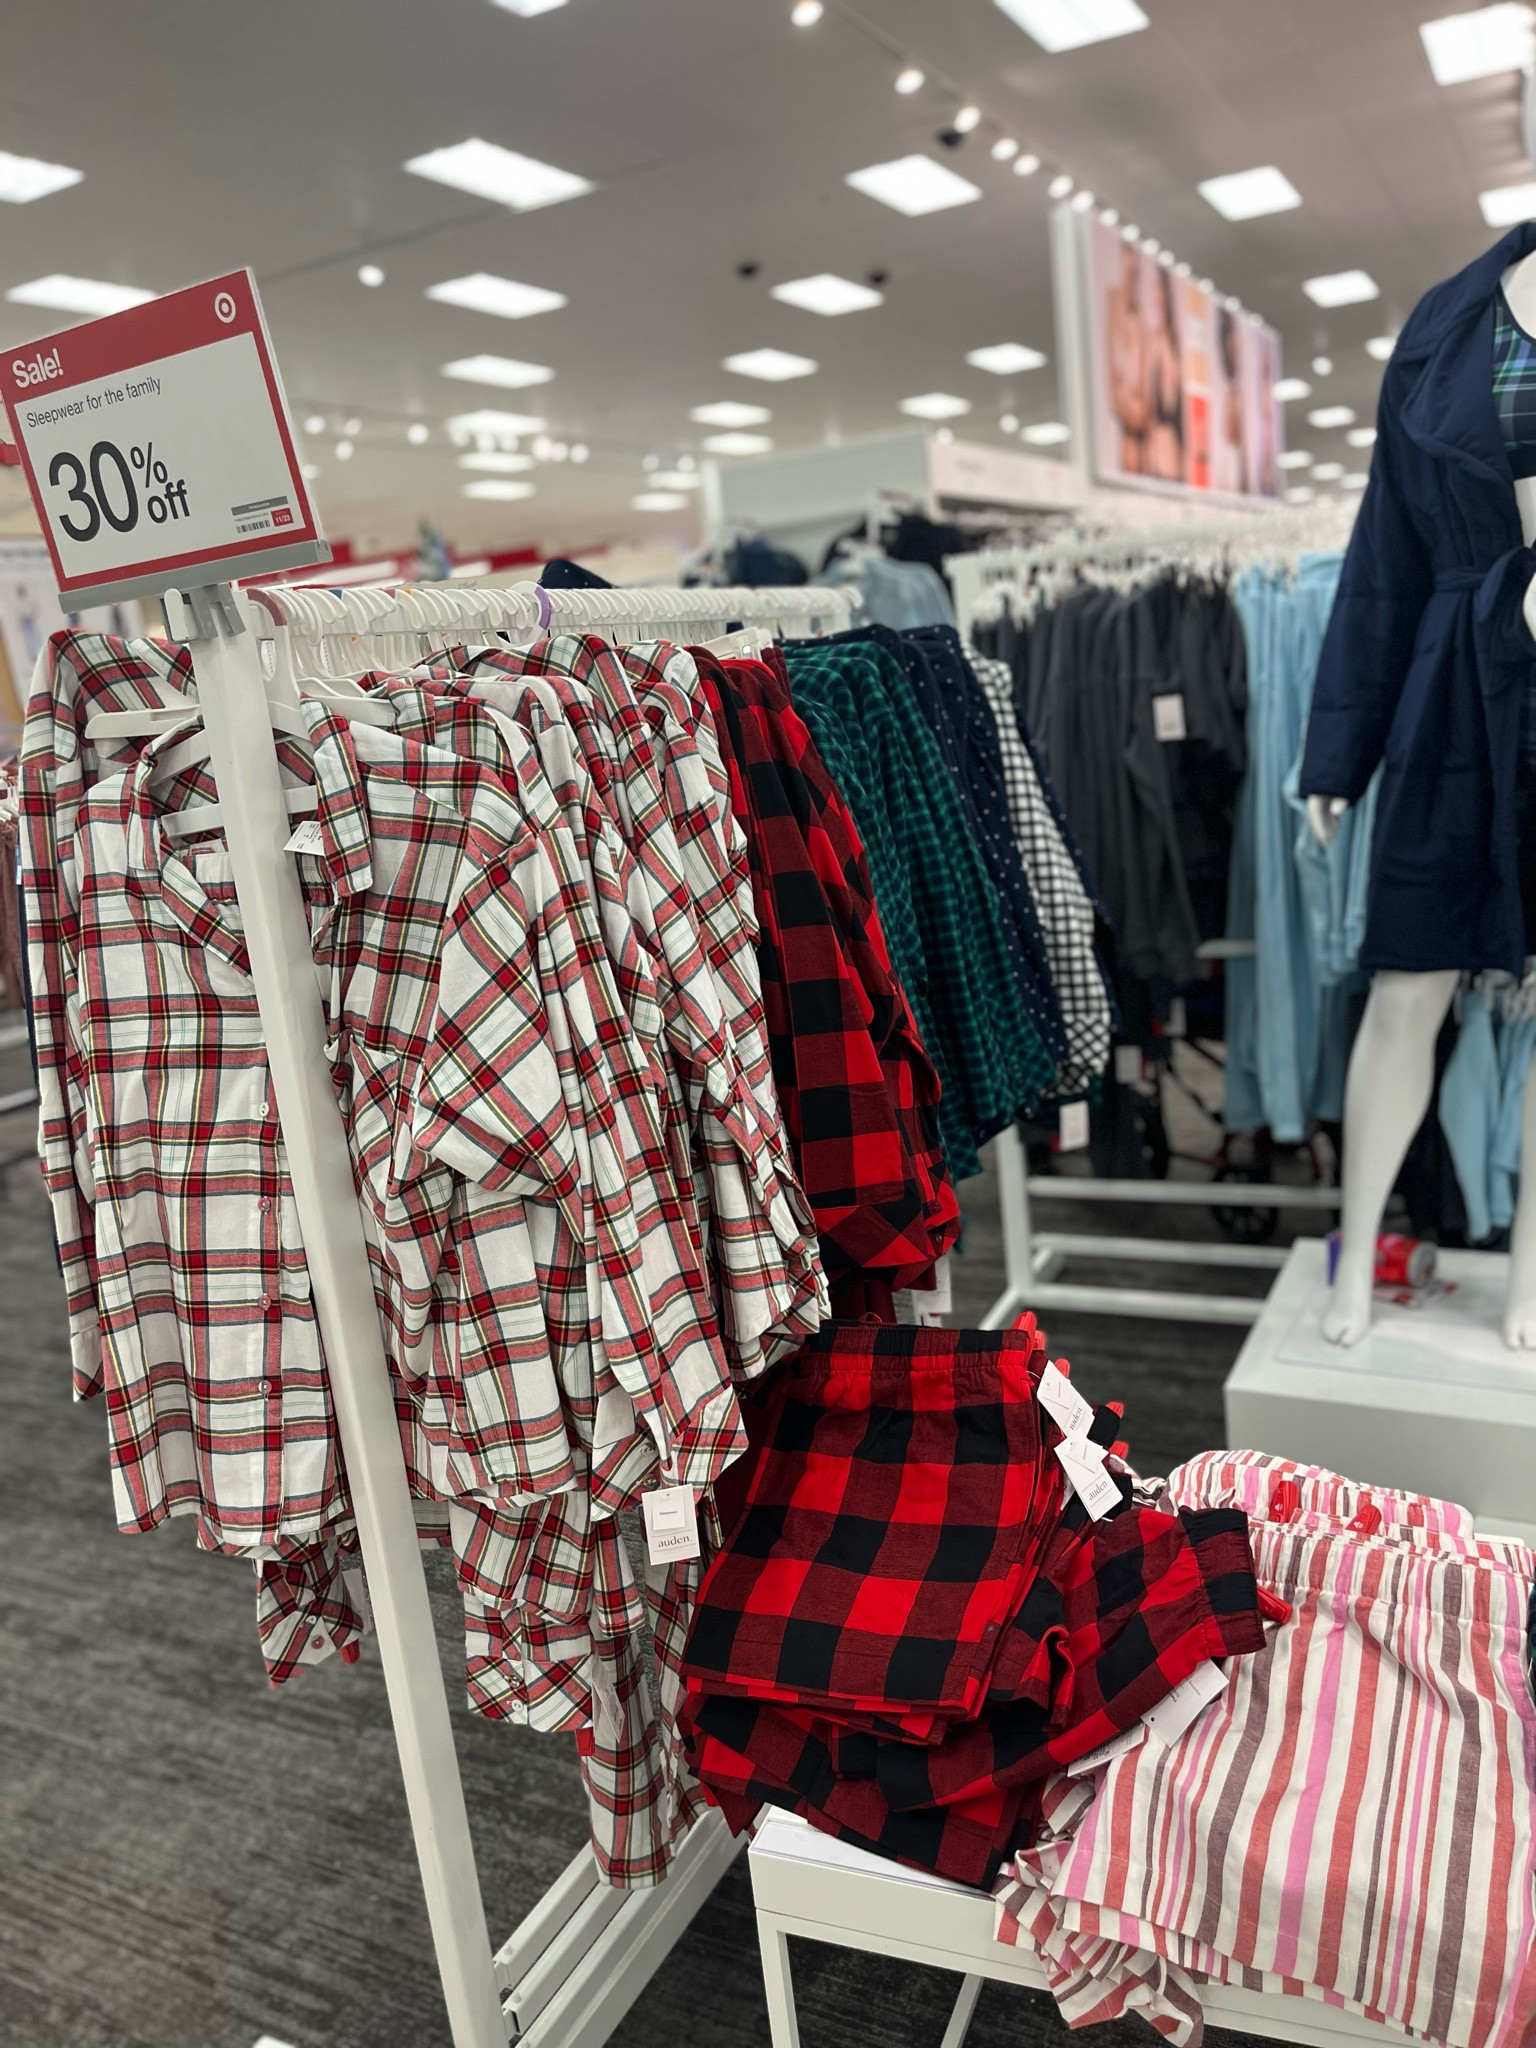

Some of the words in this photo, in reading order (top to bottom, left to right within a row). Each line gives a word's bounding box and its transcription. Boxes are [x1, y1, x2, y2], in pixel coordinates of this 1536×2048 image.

[12, 348, 64, 389] Sale!
[26, 401, 85, 428] Sleepwear
[86, 395, 102, 410] for
[104, 389, 125, 405] the
[125, 376, 161, 399] family
[147, 479, 191, 524] off
